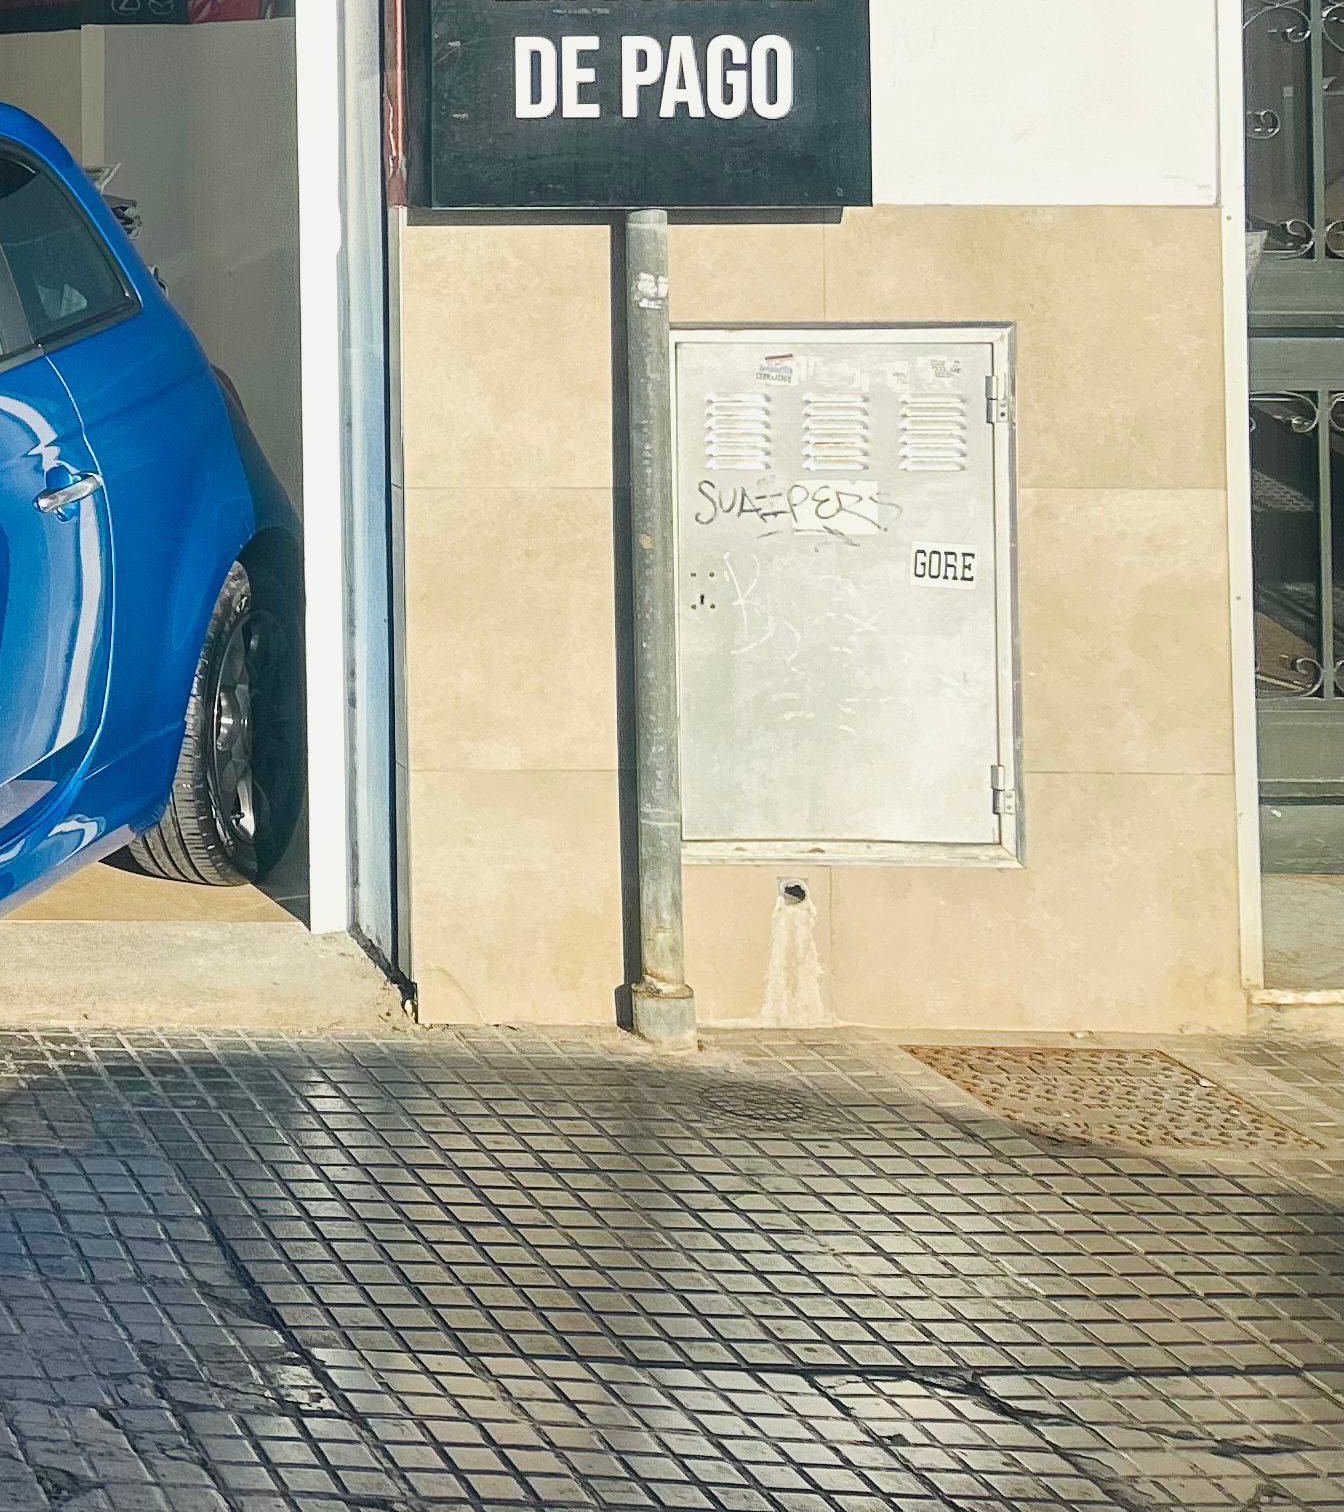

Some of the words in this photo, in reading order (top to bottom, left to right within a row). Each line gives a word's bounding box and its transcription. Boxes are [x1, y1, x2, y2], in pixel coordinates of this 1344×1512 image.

[515, 36, 600, 120] DE
[621, 35, 794, 121] PAGO
[914, 549, 976, 582] GORE
